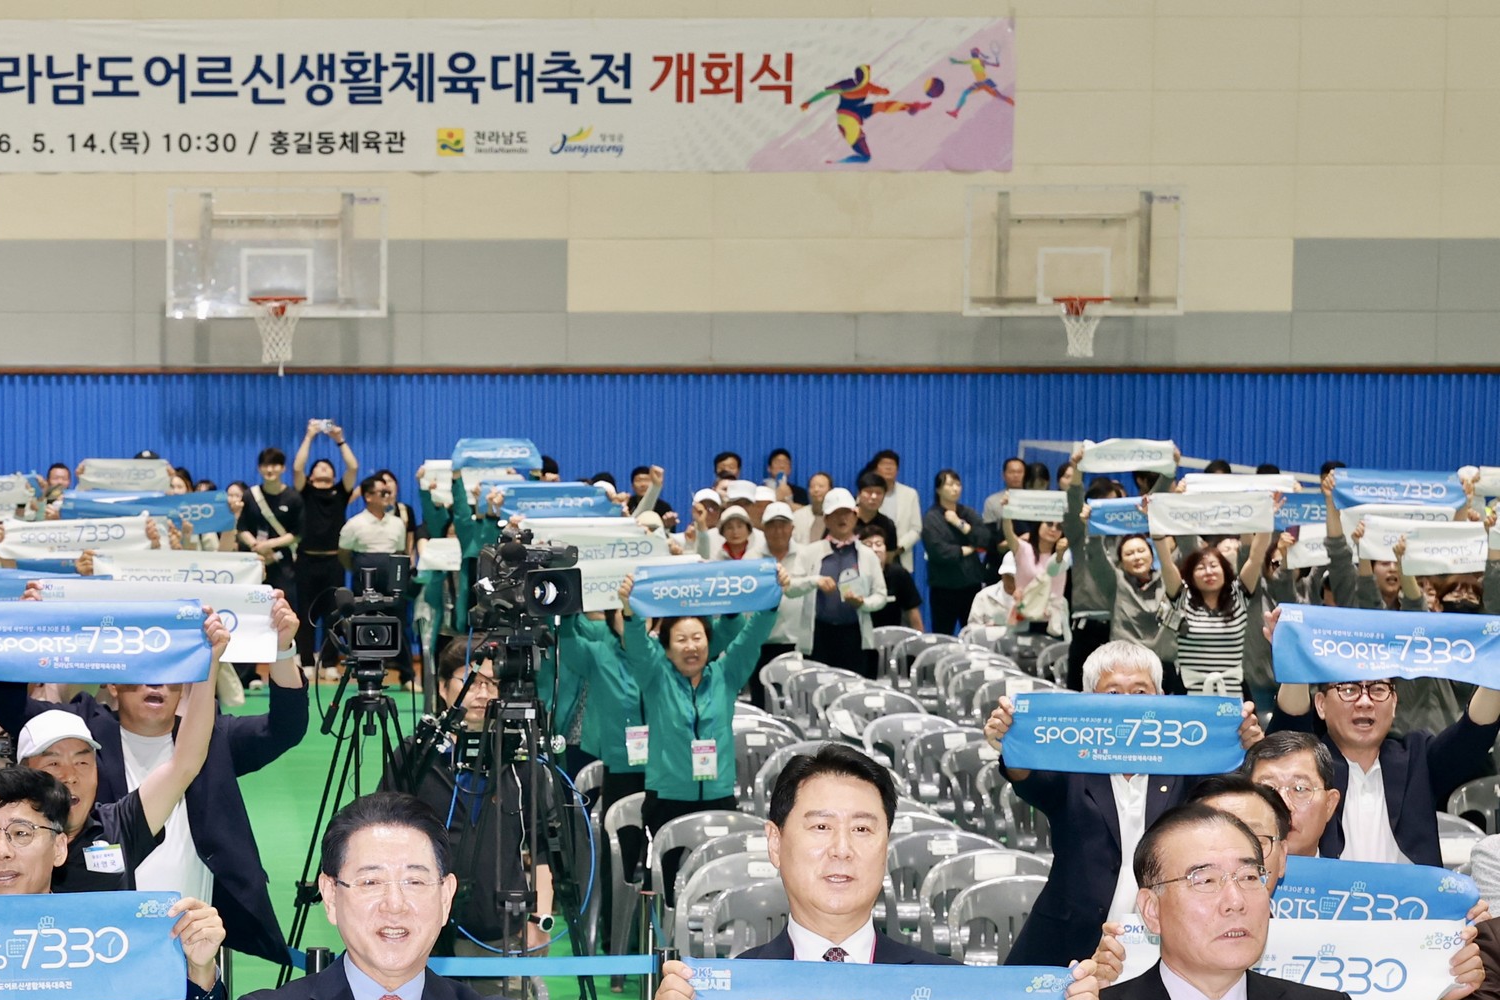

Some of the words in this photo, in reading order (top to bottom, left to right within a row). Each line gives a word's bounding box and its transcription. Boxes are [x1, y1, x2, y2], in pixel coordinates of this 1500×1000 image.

[648, 53, 795, 105] 개회식
[32, 134, 54, 154] 5.
[68, 131, 150, 155] 14.(목)
[162, 134, 237, 154] 10:30
[248, 132, 259, 155] /
[269, 129, 406, 155] 홍길동체육관
[474, 131, 529, 146] 전라남도
[1402, 482, 1447, 498] 7330
[20, 526, 72, 543] SPORTS
[72, 523, 126, 542] 7330
[652, 584, 702, 599] SPORTS
[705, 576, 758, 595] 7330
[82, 625, 172, 654] 7330
[1312, 638, 1390, 660] SPORTS
[1396, 635, 1476, 664] 7330
[1034, 727, 1116, 746] SPORTS
[1123, 718, 1208, 748] 7330
[13, 926, 129, 970] 7330
[1292, 955, 1408, 995] 7330
